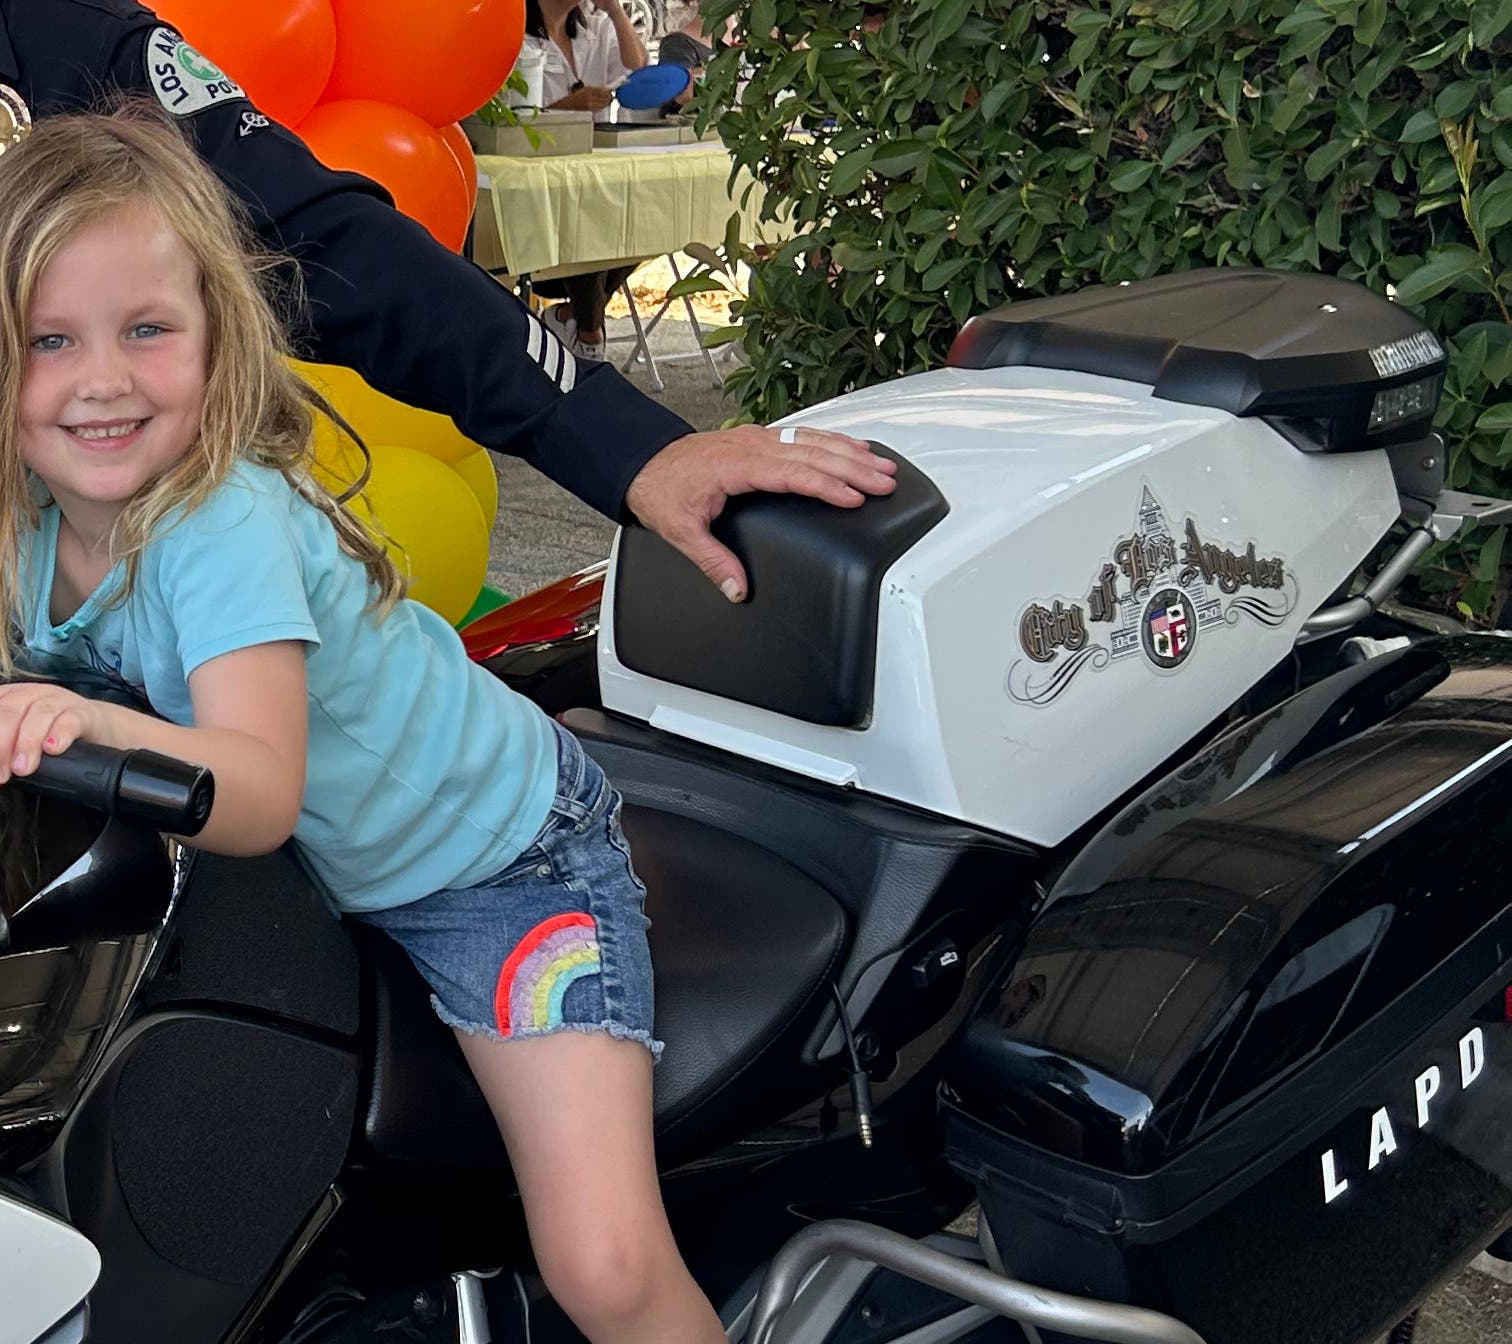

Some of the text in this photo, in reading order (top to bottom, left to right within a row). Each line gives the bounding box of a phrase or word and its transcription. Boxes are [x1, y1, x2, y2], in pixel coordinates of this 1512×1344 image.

[154, 62, 190, 107] LOS
[1018, 599, 1088, 663] City
[1088, 562, 1117, 623] of
[1113, 532, 1178, 604] Los
[1176, 517, 1285, 594] Angeles
[1321, 1026, 1485, 1204] LAPD
